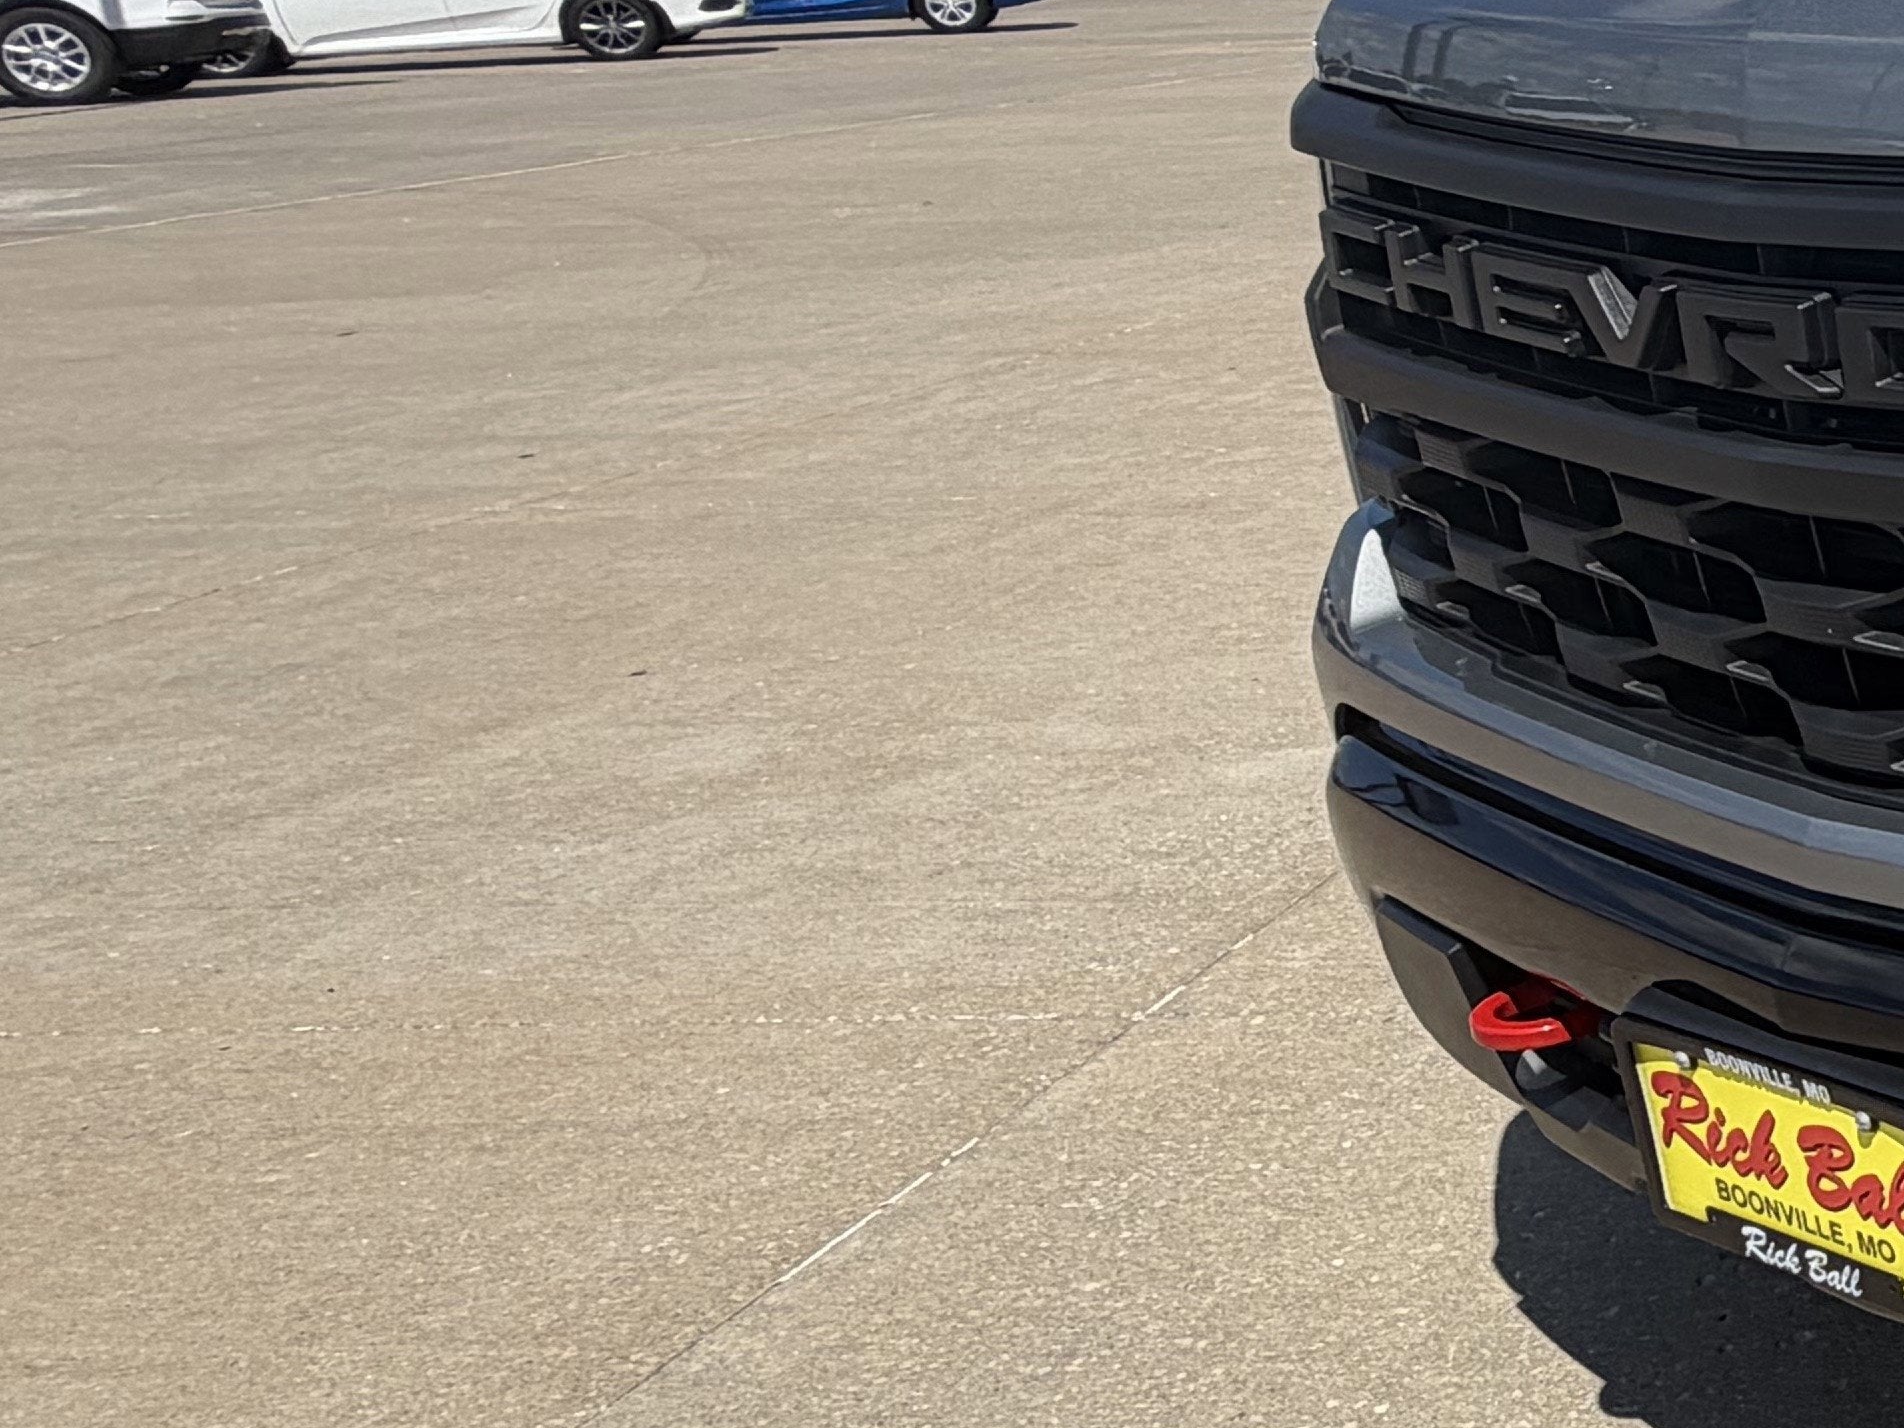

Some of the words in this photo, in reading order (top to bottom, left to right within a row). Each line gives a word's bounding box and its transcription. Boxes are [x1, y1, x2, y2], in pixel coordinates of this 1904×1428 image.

[1650, 1070, 1789, 1190] Rick
[1801, 1077, 1832, 1106] MO
[1714, 1176, 1854, 1254] BOONVILLE,
[1856, 1229, 1896, 1264] MO
[1740, 1224, 1802, 1275] Rick
[1803, 1248, 1863, 1298] Ball
